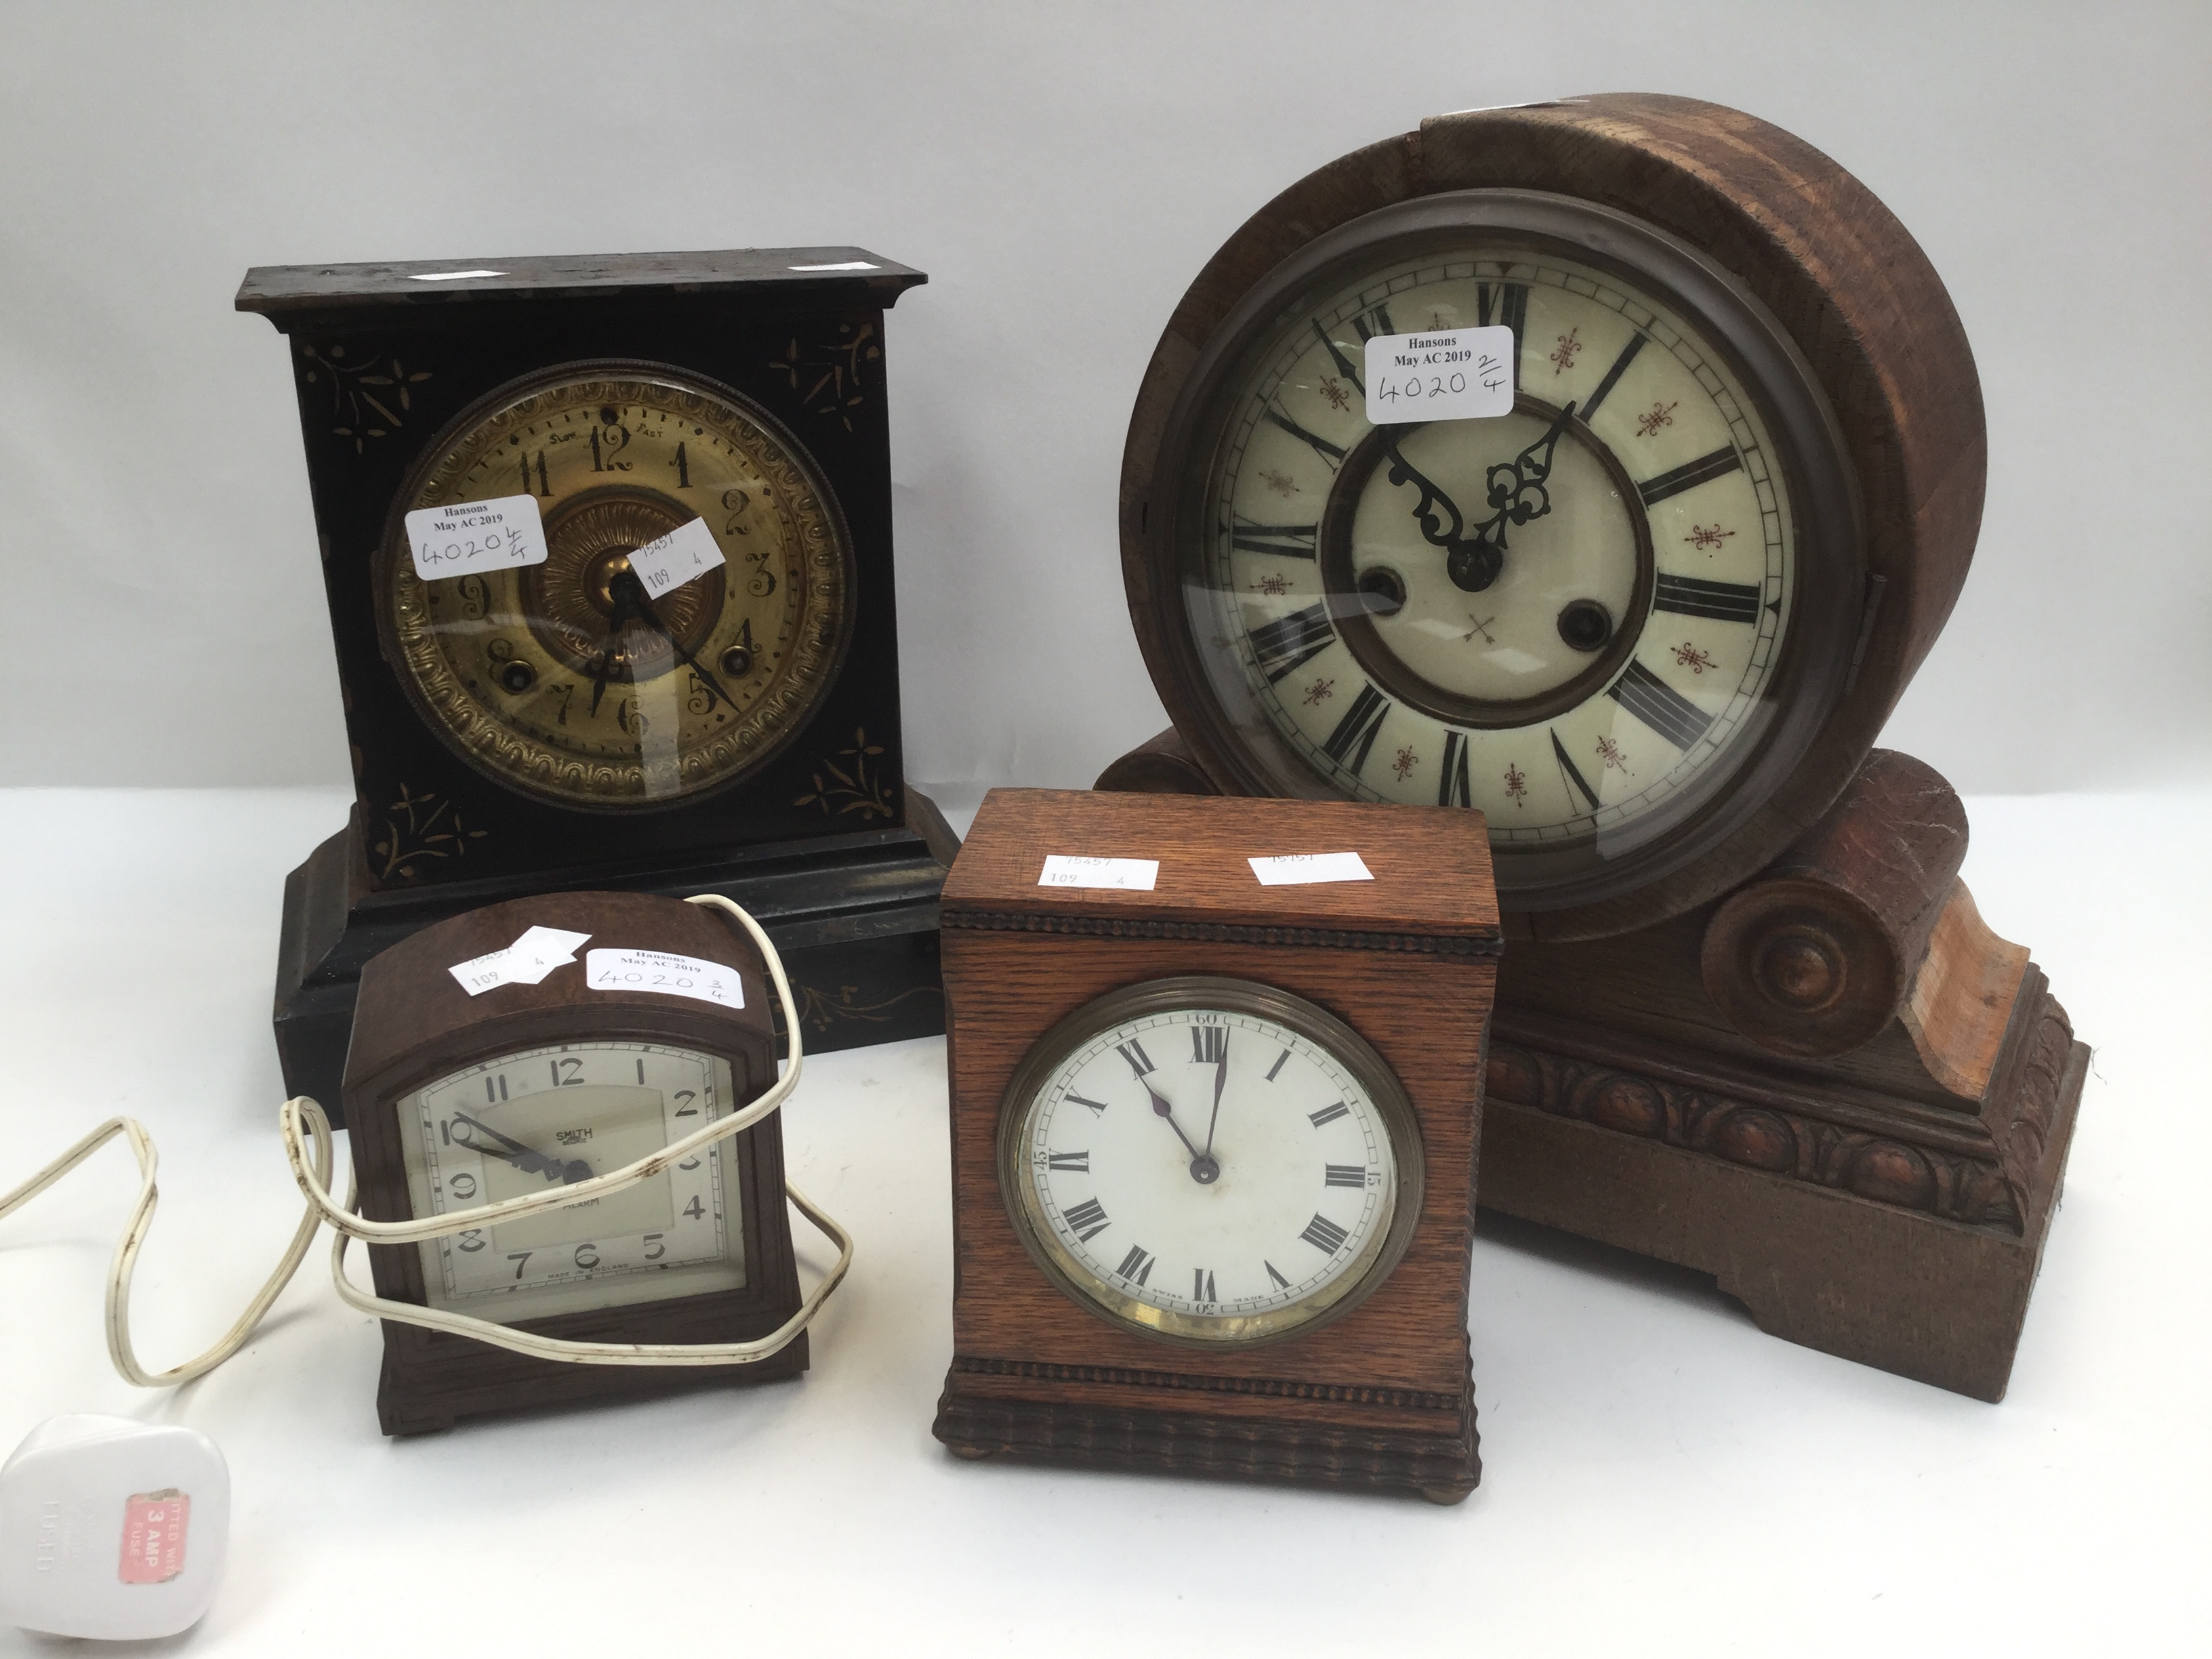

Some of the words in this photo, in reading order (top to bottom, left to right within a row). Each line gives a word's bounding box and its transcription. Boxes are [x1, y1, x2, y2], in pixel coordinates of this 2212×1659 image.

[1408, 337, 1456, 349] Hansons
[1395, 356, 1419, 367] May
[1423, 352, 1441, 363] AC
[1444, 350, 1471, 363] 2019
[1379, 373, 1466, 403] 4020
[583, 424, 633, 472] 12
[520, 450, 556, 497] 11
[669, 441, 693, 489] 1
[434, 522, 457, 532] May
[461, 518, 476, 528] AC
[480, 514, 503, 525] 2019
[445, 504, 488, 516] Hansons
[721, 489, 750, 535] 2
[422, 534, 501, 565] 4020
[648, 569, 669, 588] 109
[693, 552, 702, 565] 4
[745, 552, 777, 598] 3
[458, 575, 491, 621] 9
[545, 684, 574, 726] 7
[688, 673, 718, 715] 5
[617, 695, 651, 737] 6
[1052, 874, 1078, 882] 109
[1116, 876, 1125, 885] 4
[620, 957, 647, 966] May
[674, 964, 701, 973] 2019
[636, 951, 686, 963] Hansons
[471, 971, 499, 987] 109
[535, 957, 544, 965] 4
[598, 970, 693, 988] 4020
[1195, 1015, 1218, 1025] 60
[550, 1057, 585, 1087] 12
[636, 1059, 644, 1085] 1
[485, 1074, 508, 1103] 11
[674, 1090, 698, 1118] 2
[441, 1118, 472, 1146] 10
[556, 1128, 593, 1141] SMITH
[1033, 1151, 1047, 1170] 45
[449, 1172, 476, 1200] 9
[1367, 1172, 1381, 1186] 15
[682, 1195, 705, 1221] 4
[575, 1243, 600, 1269] 6
[643, 1233, 665, 1260] 5
[506, 1252, 533, 1279] 7
[590, 1263, 629, 1273] ENGLAND
[1152, 1288, 1183, 1300] SWISS
[1233, 1294, 1265, 1303] MADE
[1195, 1303, 1214, 1315] 30
[148, 1510, 165, 1522] 3
[129, 1522, 142, 1557] FUSE
[145, 1530, 161, 1568] AMP
